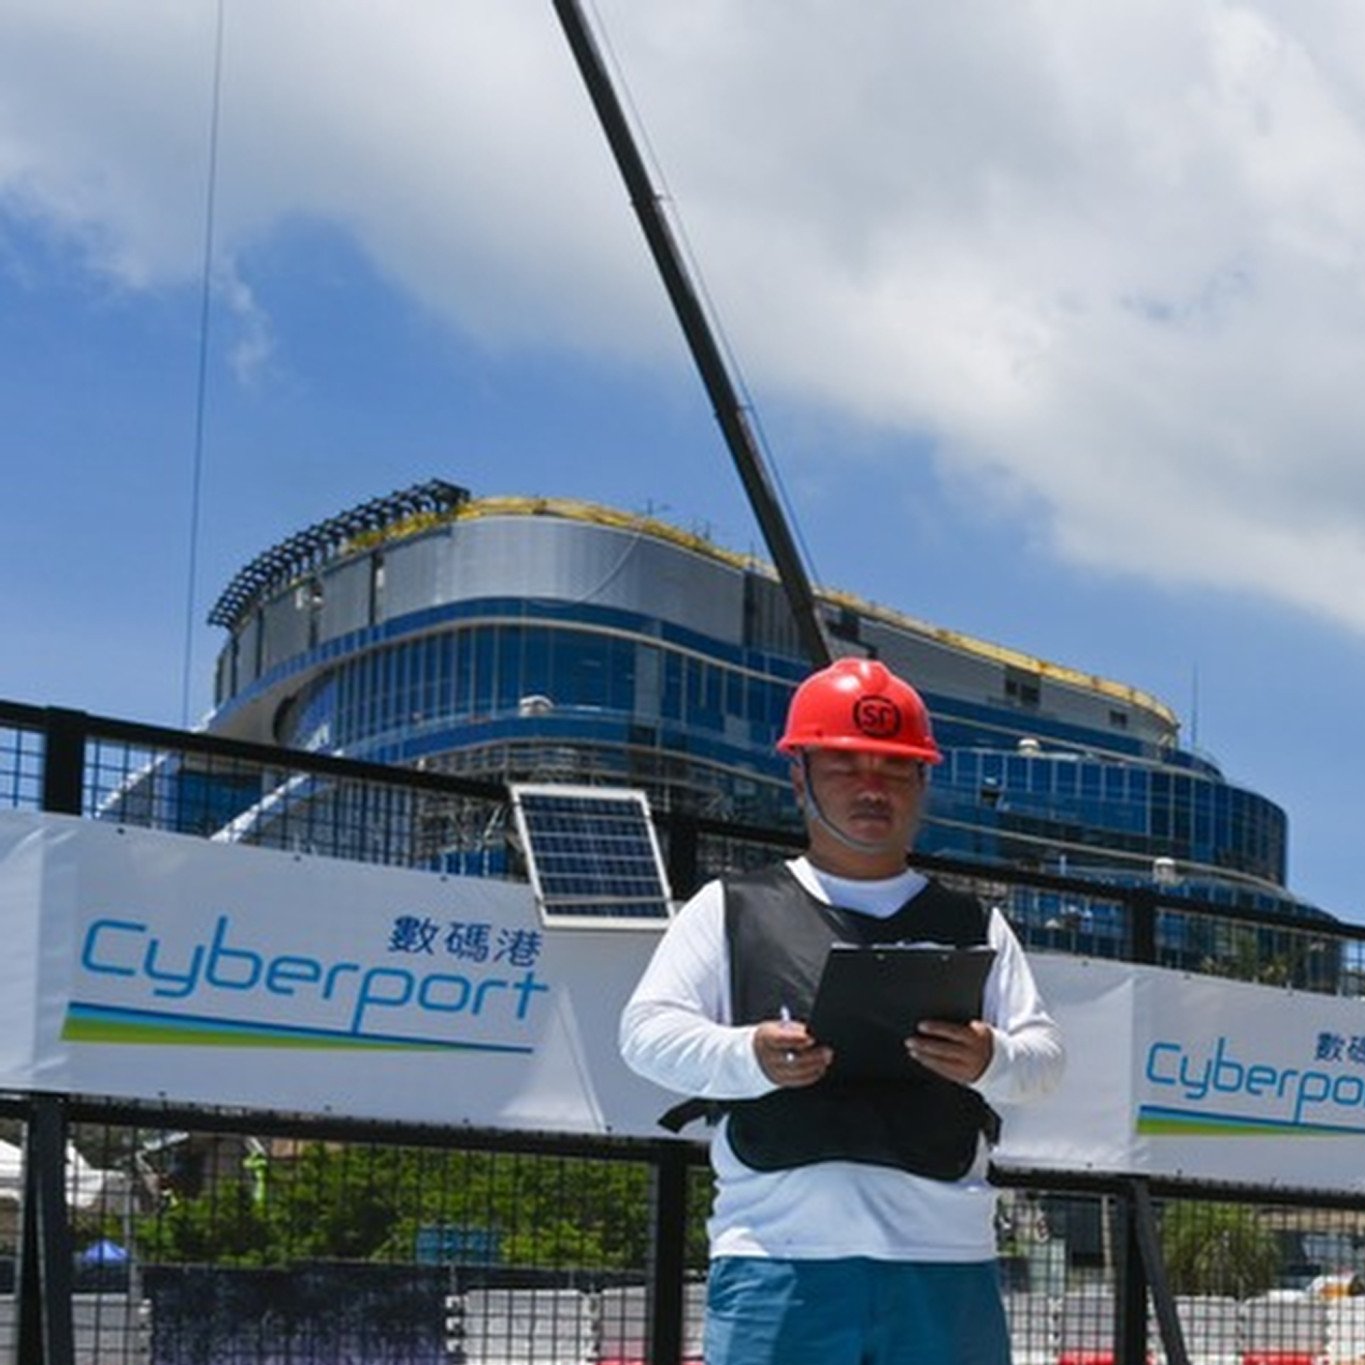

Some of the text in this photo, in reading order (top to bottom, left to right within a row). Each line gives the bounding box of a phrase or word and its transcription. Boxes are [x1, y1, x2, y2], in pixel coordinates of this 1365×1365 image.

[81, 916, 550, 1033] Cyberport
[388, 915, 543, 968] 數碼港
